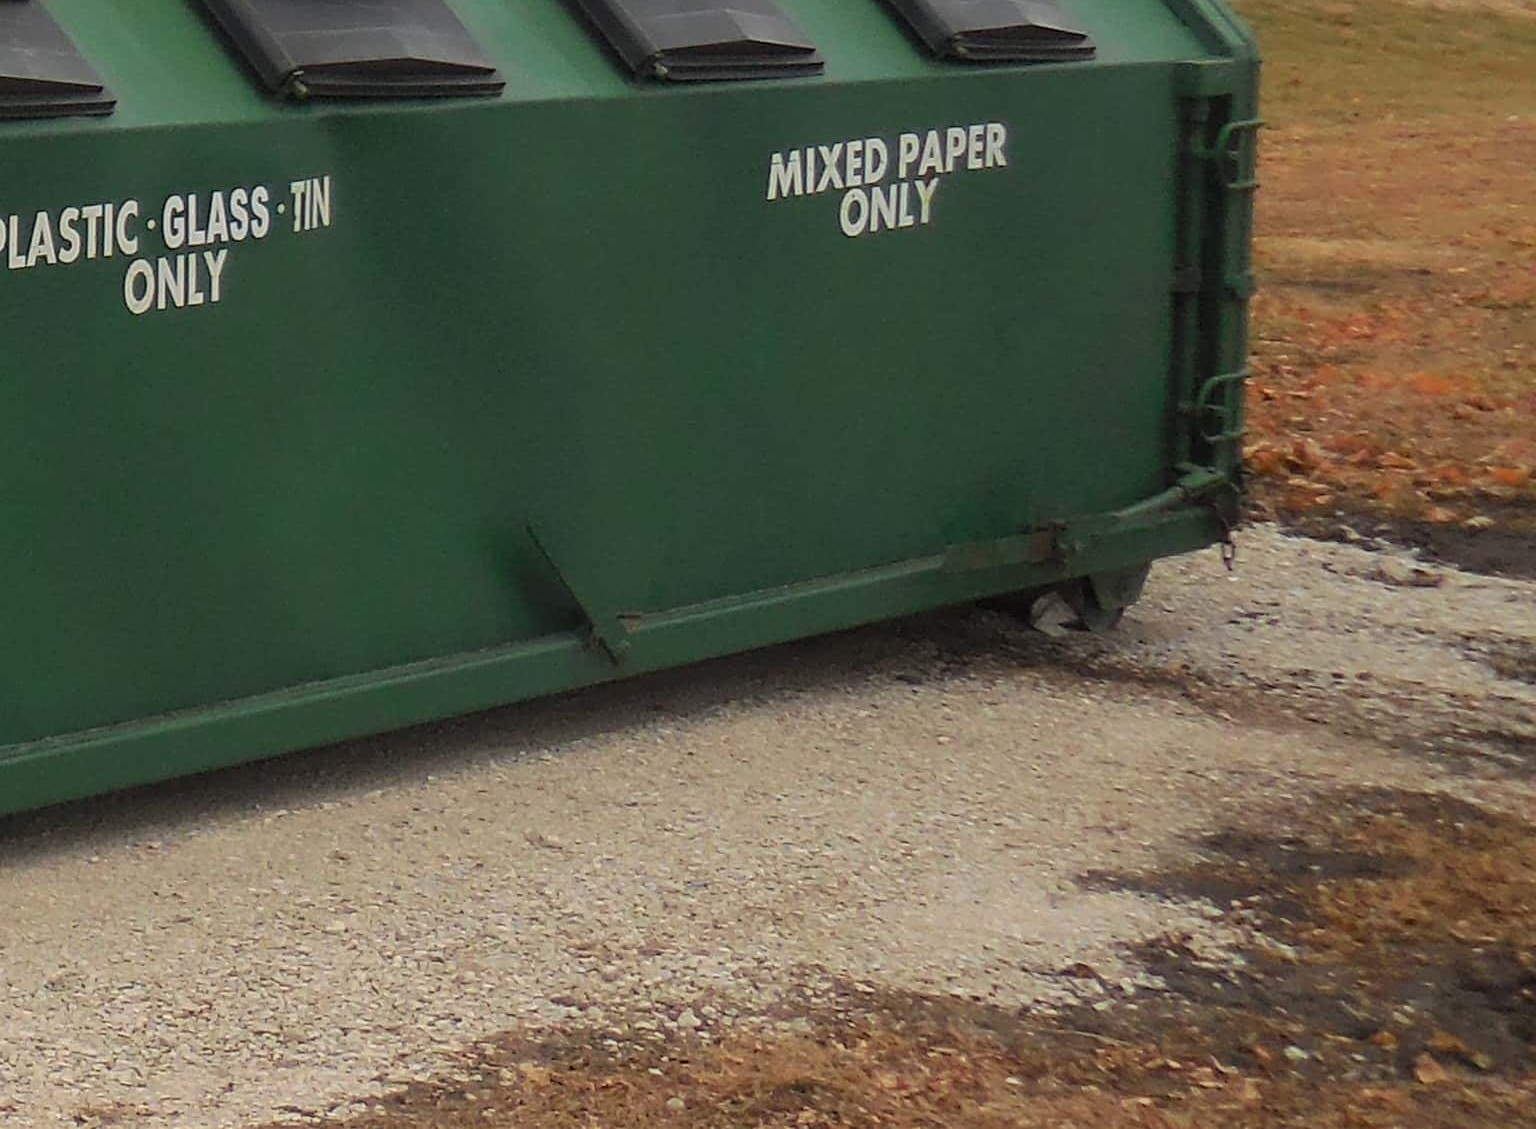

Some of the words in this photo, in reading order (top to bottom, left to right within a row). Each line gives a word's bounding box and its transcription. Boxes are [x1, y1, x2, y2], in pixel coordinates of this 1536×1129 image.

[766, 136, 889, 200] MIXED
[898, 122, 1007, 179] PAPER
[163, 185, 270, 249] GLASS
[290, 175, 331, 232] TIN
[839, 177, 940, 237] ONLY
[124, 248, 228, 315] ONLY
